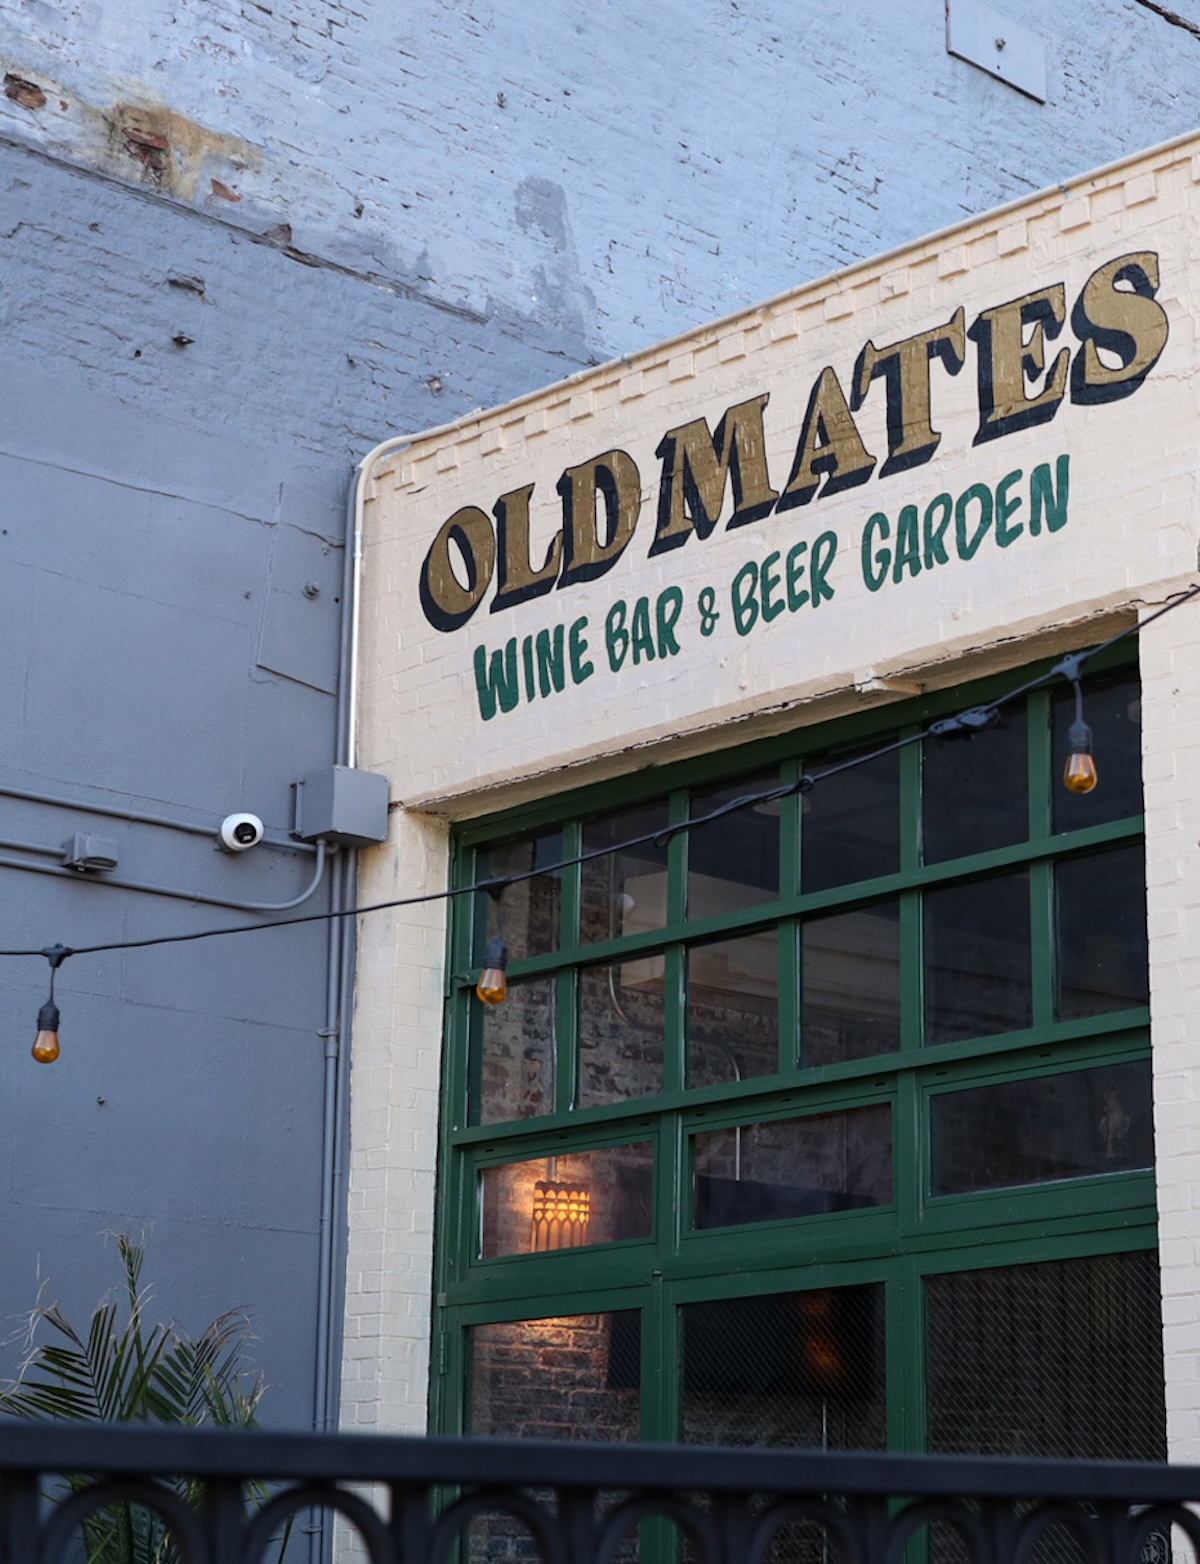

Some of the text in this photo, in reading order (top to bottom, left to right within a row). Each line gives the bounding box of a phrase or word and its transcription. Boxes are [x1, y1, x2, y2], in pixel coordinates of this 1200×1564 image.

[474, 454, 1070, 721] WINE BAR & BEER GARDEN
